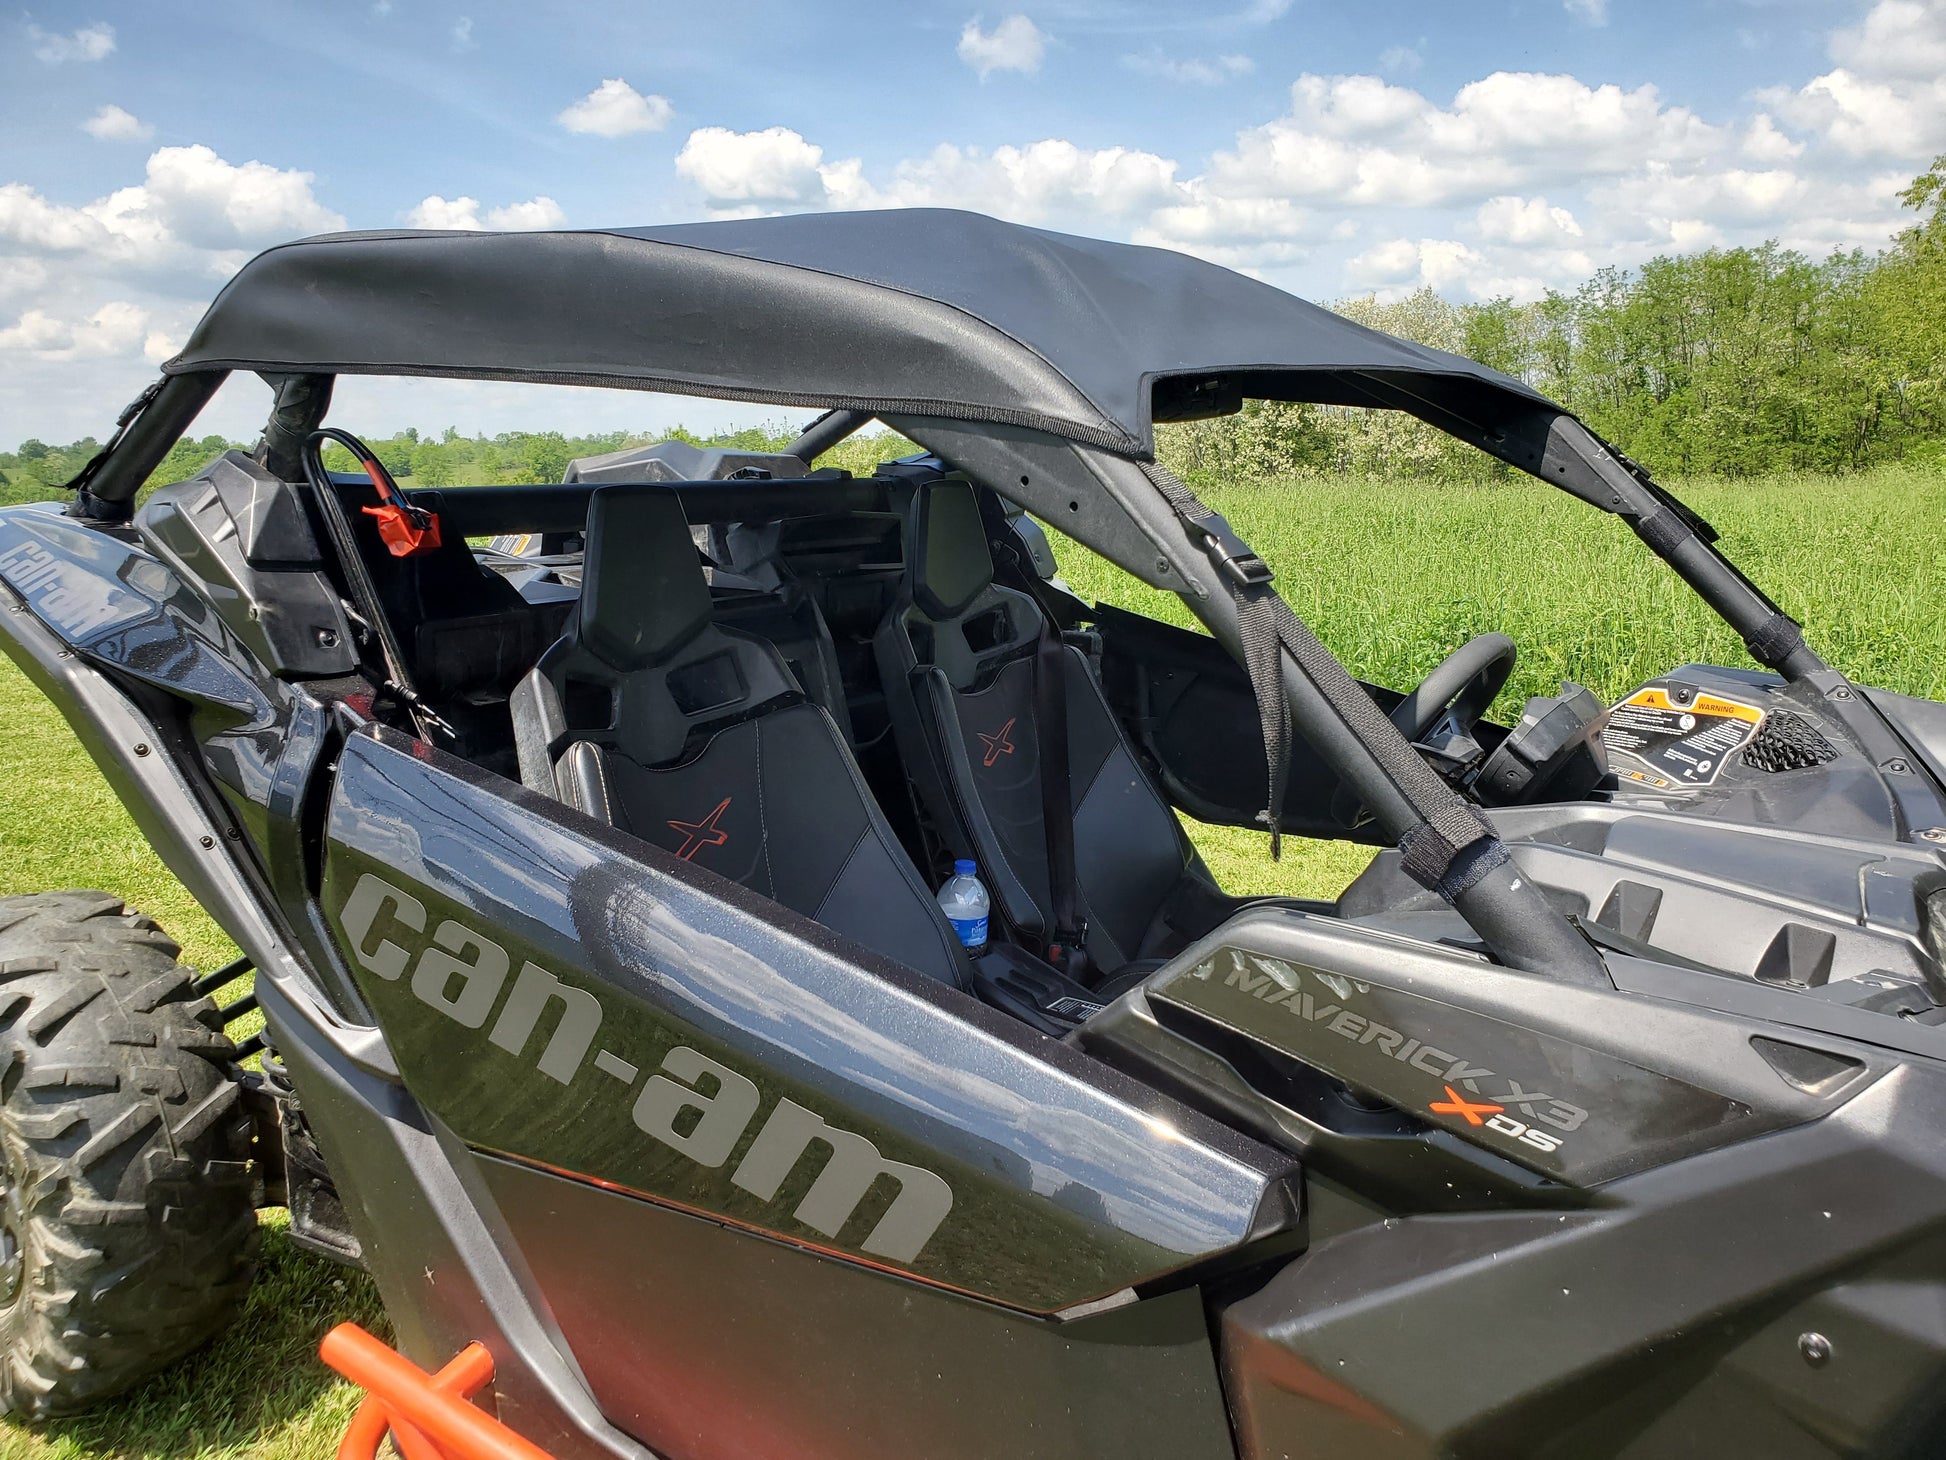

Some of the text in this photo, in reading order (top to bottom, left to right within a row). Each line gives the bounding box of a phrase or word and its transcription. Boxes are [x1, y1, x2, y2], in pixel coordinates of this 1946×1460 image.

[0, 540, 120, 638] can-am
[1698, 703, 1735, 714] WARNING
[339, 872, 954, 1265] can-am
[1223, 967, 1589, 1133] MAVERICK X3
